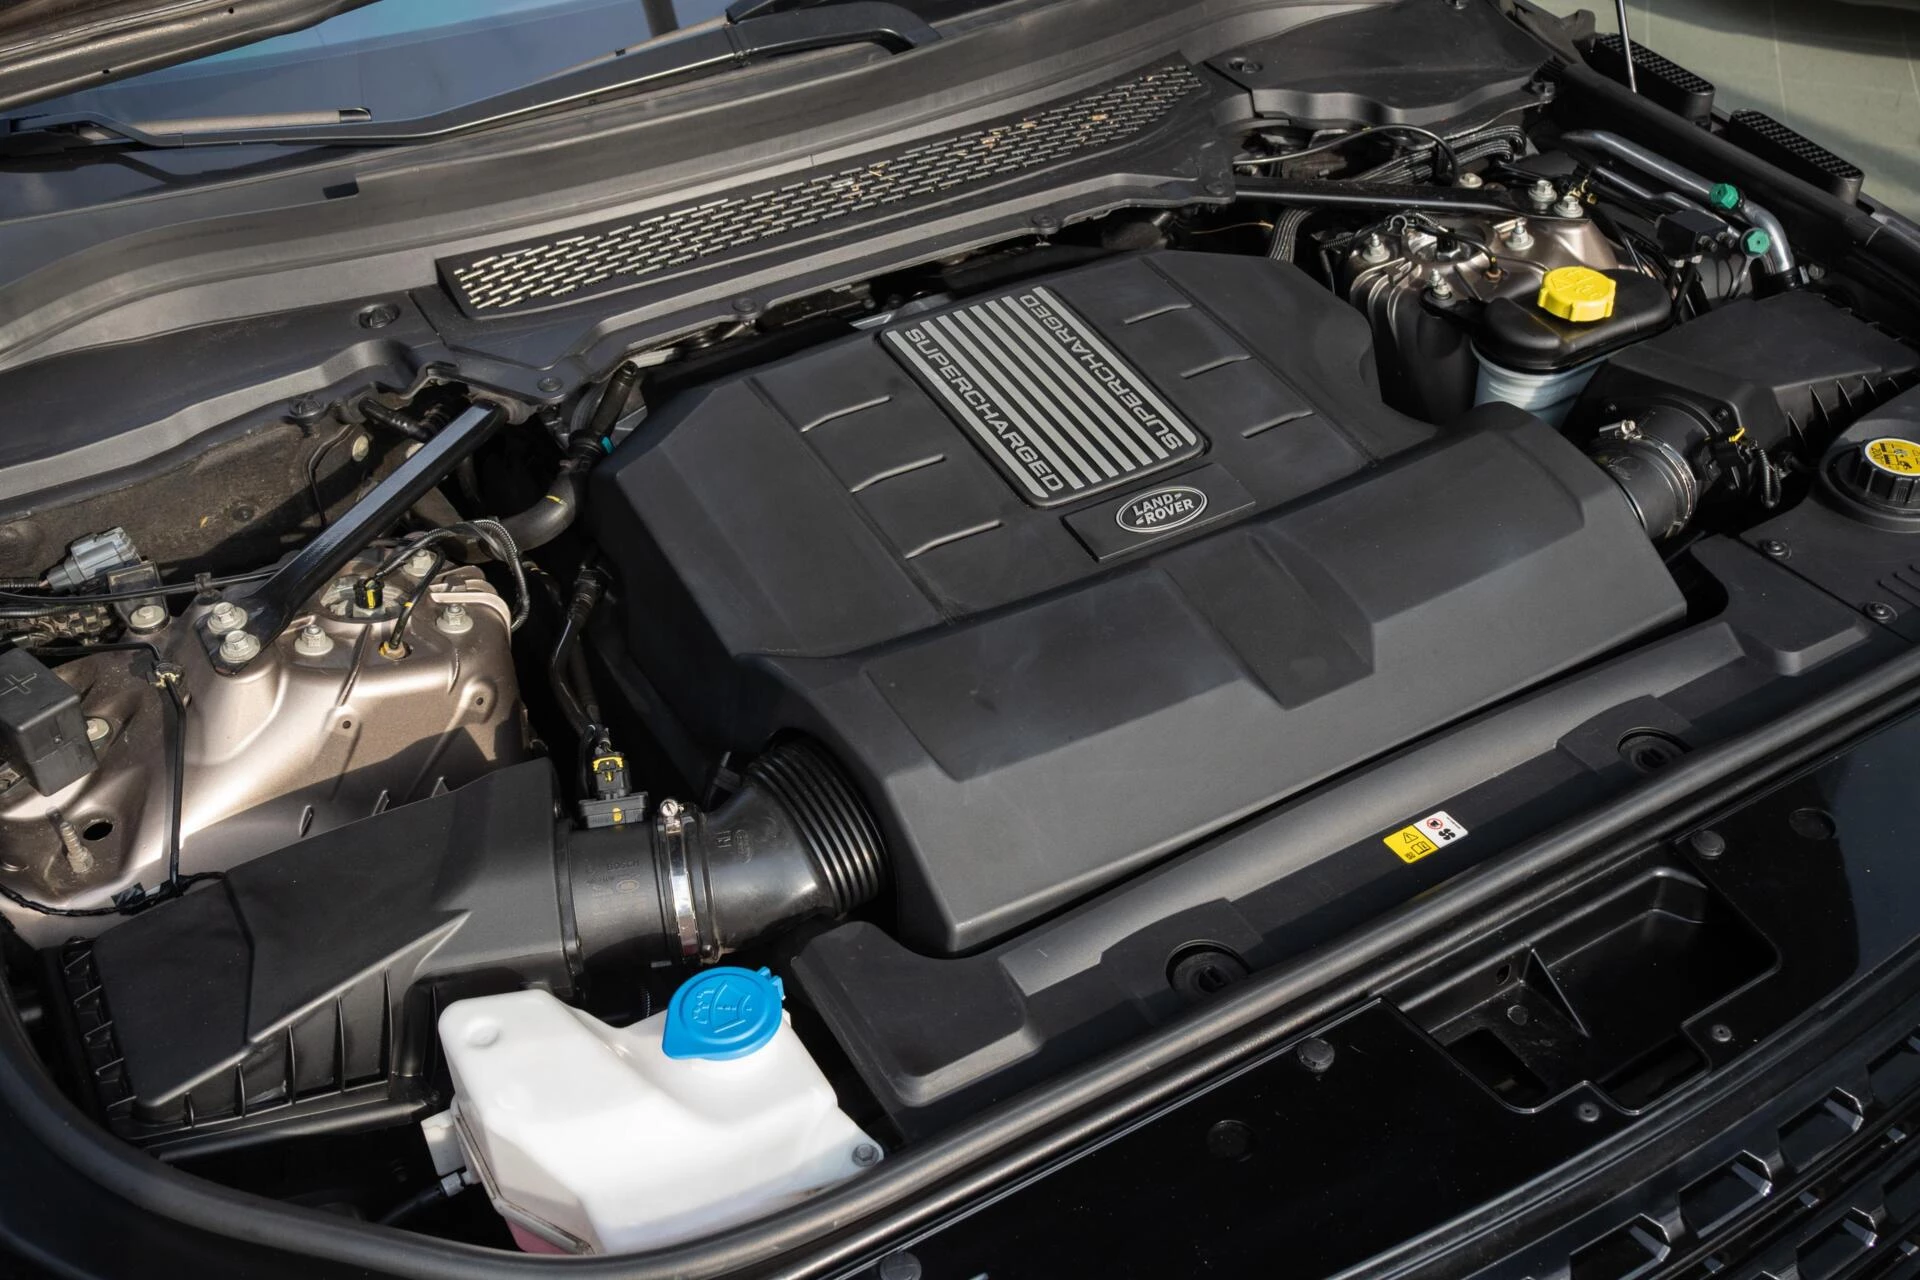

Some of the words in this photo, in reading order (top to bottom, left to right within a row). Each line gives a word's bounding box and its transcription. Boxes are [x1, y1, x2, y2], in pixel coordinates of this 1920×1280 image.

[904, 328, 1064, 491] SUPERCHARGED
[1019, 294, 1183, 450] SUPERCHARGED
[1132, 493, 1174, 516] LAND
[1144, 498, 1195, 525] ROVER
